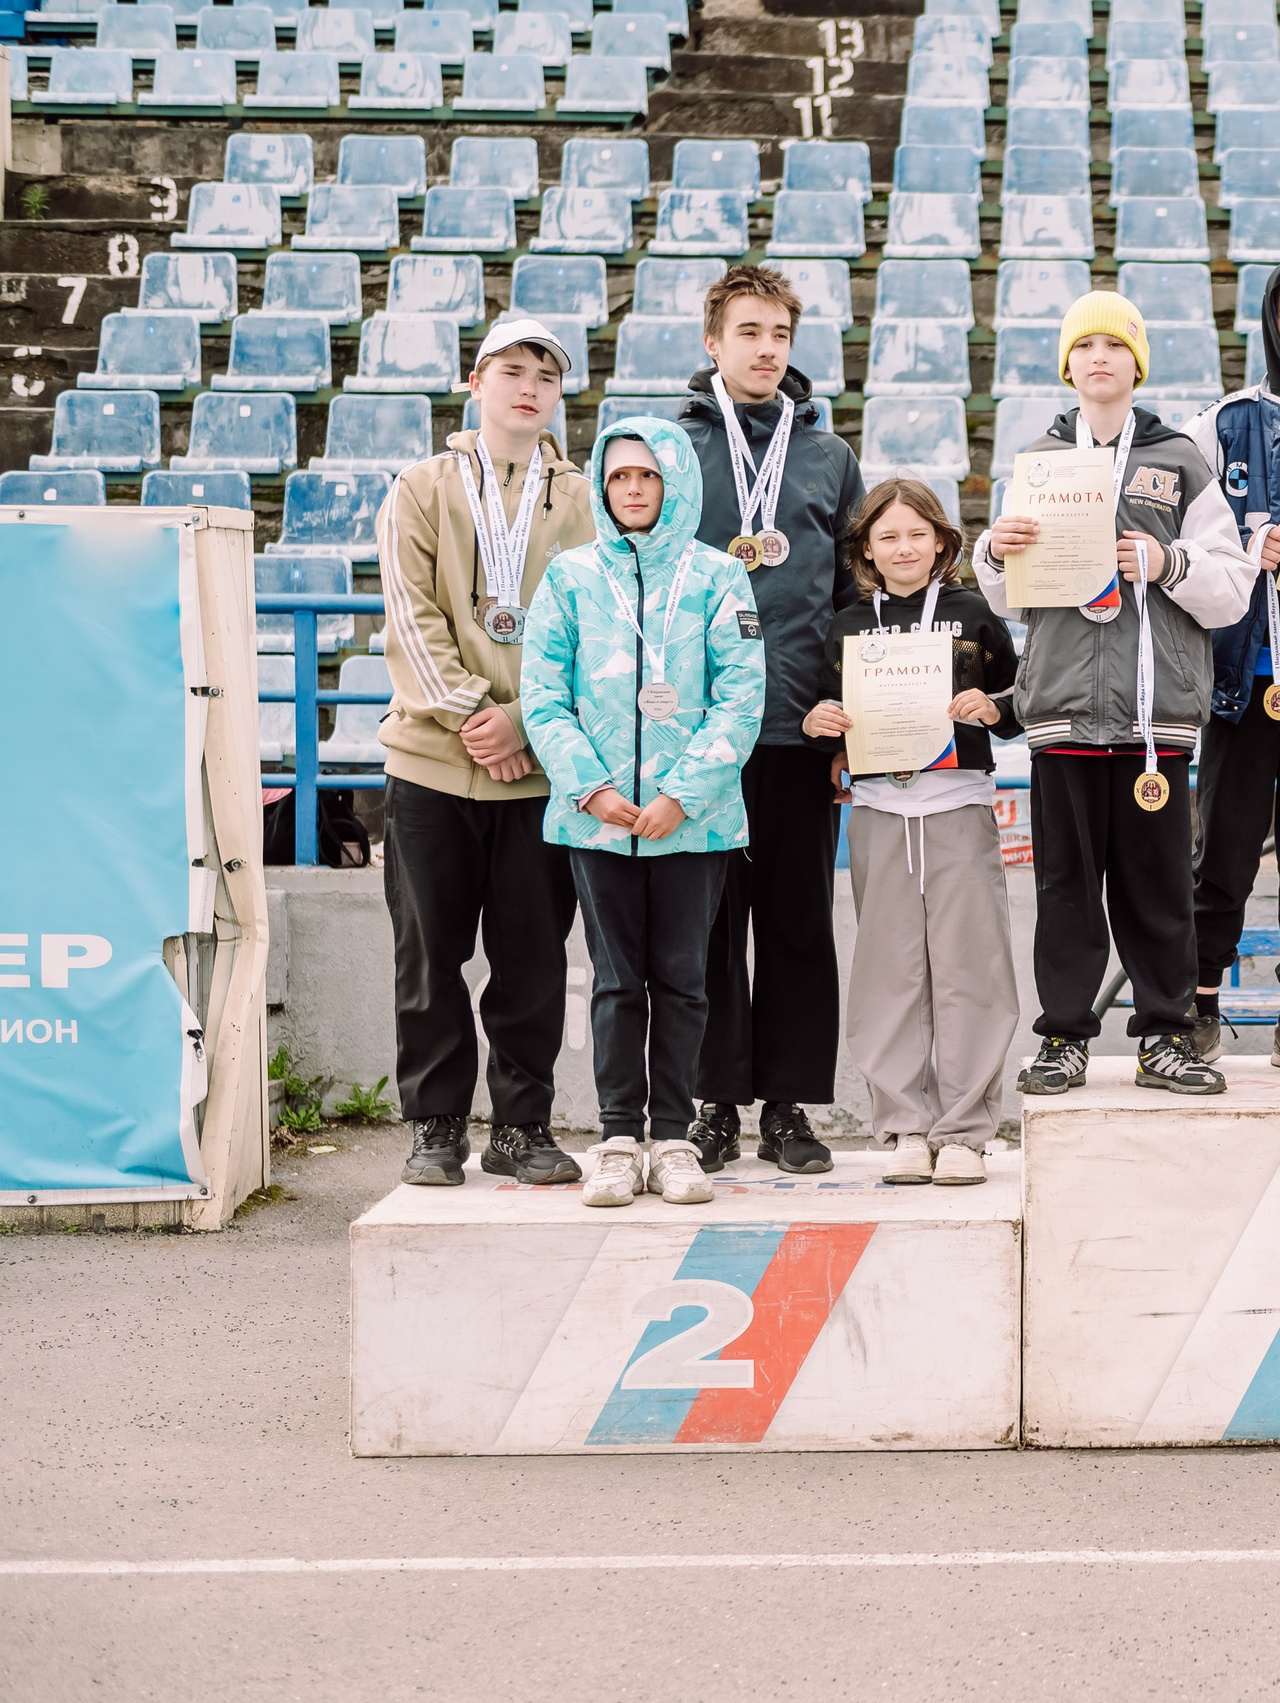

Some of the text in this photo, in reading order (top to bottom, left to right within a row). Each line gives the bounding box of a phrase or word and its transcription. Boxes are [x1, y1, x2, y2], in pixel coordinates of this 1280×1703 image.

[818, 20, 865, 59] 13
[805, 57, 854, 97] 12
[793, 95, 832, 138] 11
[108, 233, 140, 277] 8
[57, 277, 87, 324] 7
[767, 483, 777, 512] Пасхальный
[1029, 492, 1104, 505] ГРАМОТА
[1125, 466, 1181, 506] ACL
[504, 557, 516, 587] Пасхальный
[1272, 635, 1280, 665] Пасхальный
[864, 665, 942, 678] ГРАМОТА
[1, 1019, 78, 1043] ИОН
[620, 1279, 755, 1389] 2
